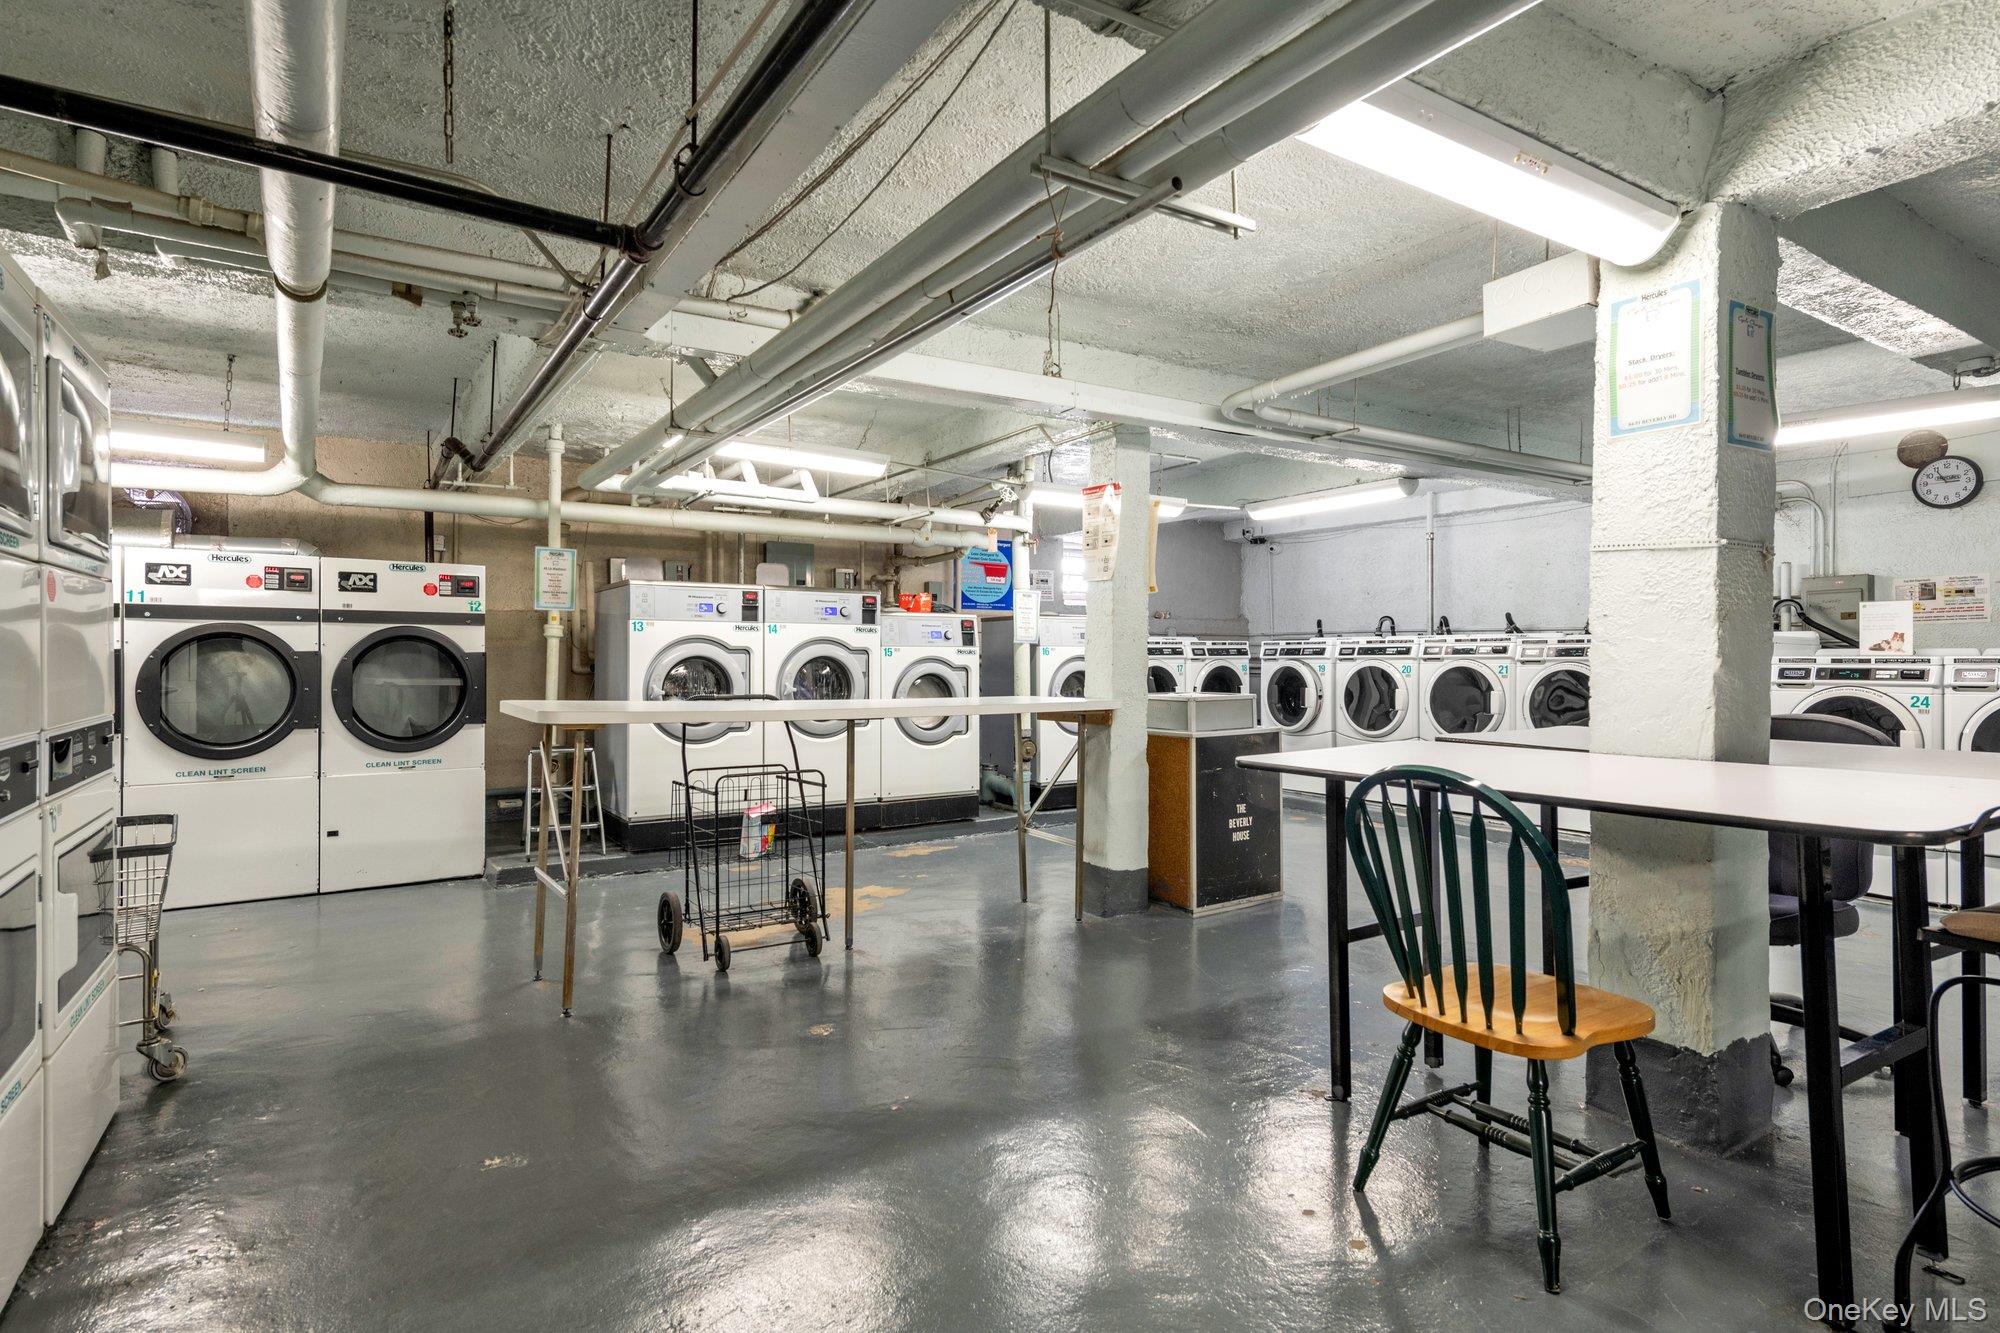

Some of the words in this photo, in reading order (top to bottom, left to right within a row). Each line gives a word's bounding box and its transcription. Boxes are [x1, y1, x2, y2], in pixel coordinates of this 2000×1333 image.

[1641, 289, 1668, 301] Hercules
[211, 553, 249, 564] Hercules
[391, 563, 424, 573] Hercules
[126, 590, 146, 603] 11
[467, 600, 482, 612] 12
[631, 621, 644, 633] 13
[767, 624, 778, 635] 14
[855, 626, 878, 634] Hercules
[884, 648, 893, 657] 15
[1042, 647, 1050, 657] 16
[1177, 664, 1184, 673] 17
[1241, 664, 1248, 673] 18
[1318, 664, 1326, 673] 19
[1401, 665, 1412, 674] 20
[1498, 665, 1509, 674] 21
[1910, 695, 1931, 709] 24
[365, 761, 389, 769] CLEAN
[392, 760, 409, 768] LINT
[411, 758, 443, 767] SCREEN
[175, 769, 206, 779] CLEAN
[208, 768, 228, 777] LINT
[230, 766, 267, 776] SCREEN
[1236, 803, 1247, 814] THE
[1228, 816, 1253, 829] BEVERLY
[1232, 831, 1250, 842] HOUSE
